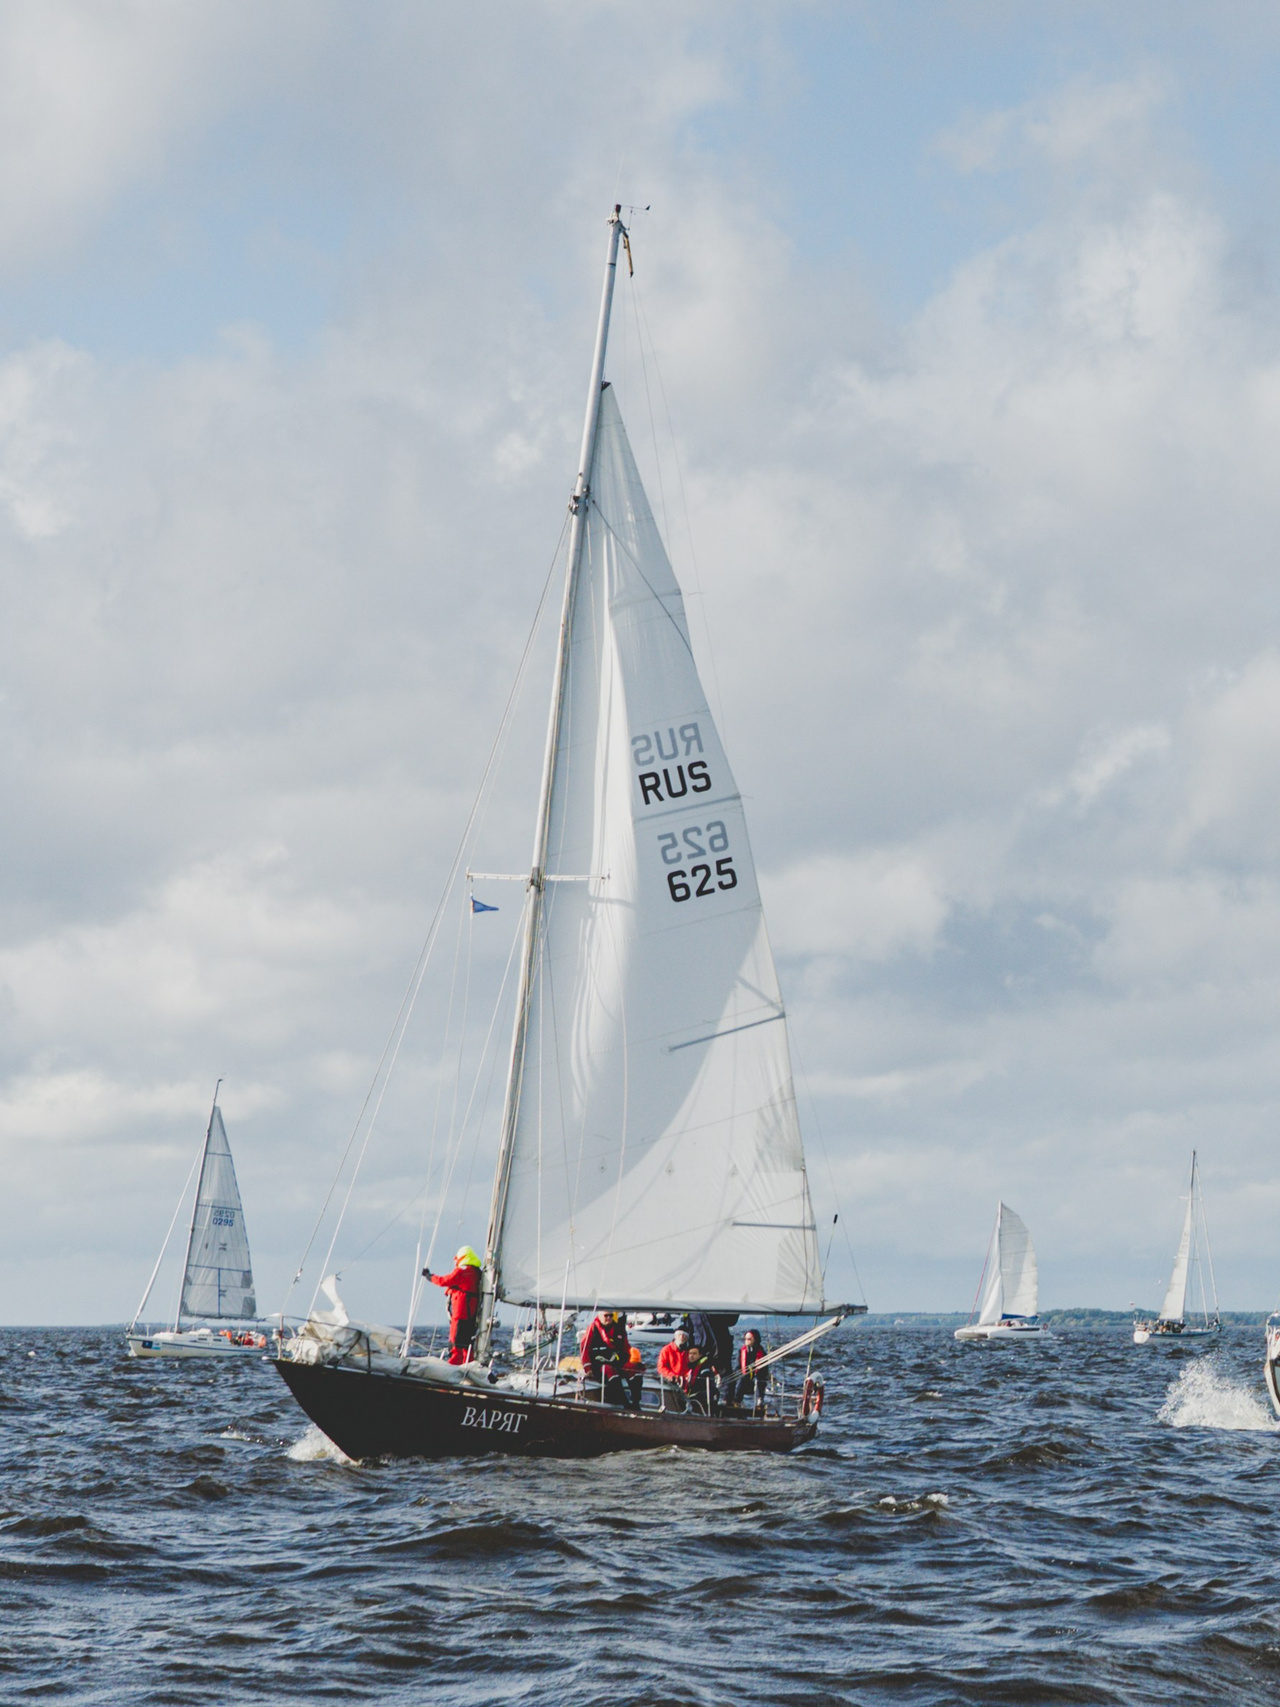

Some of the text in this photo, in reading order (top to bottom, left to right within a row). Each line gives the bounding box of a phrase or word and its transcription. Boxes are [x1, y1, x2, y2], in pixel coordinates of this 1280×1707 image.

[638, 760, 712, 805] RUS
[666, 856, 738, 903] 625
[212, 1217, 234, 1227] 0295
[460, 1406, 528, 1433] ВАРЯГ
